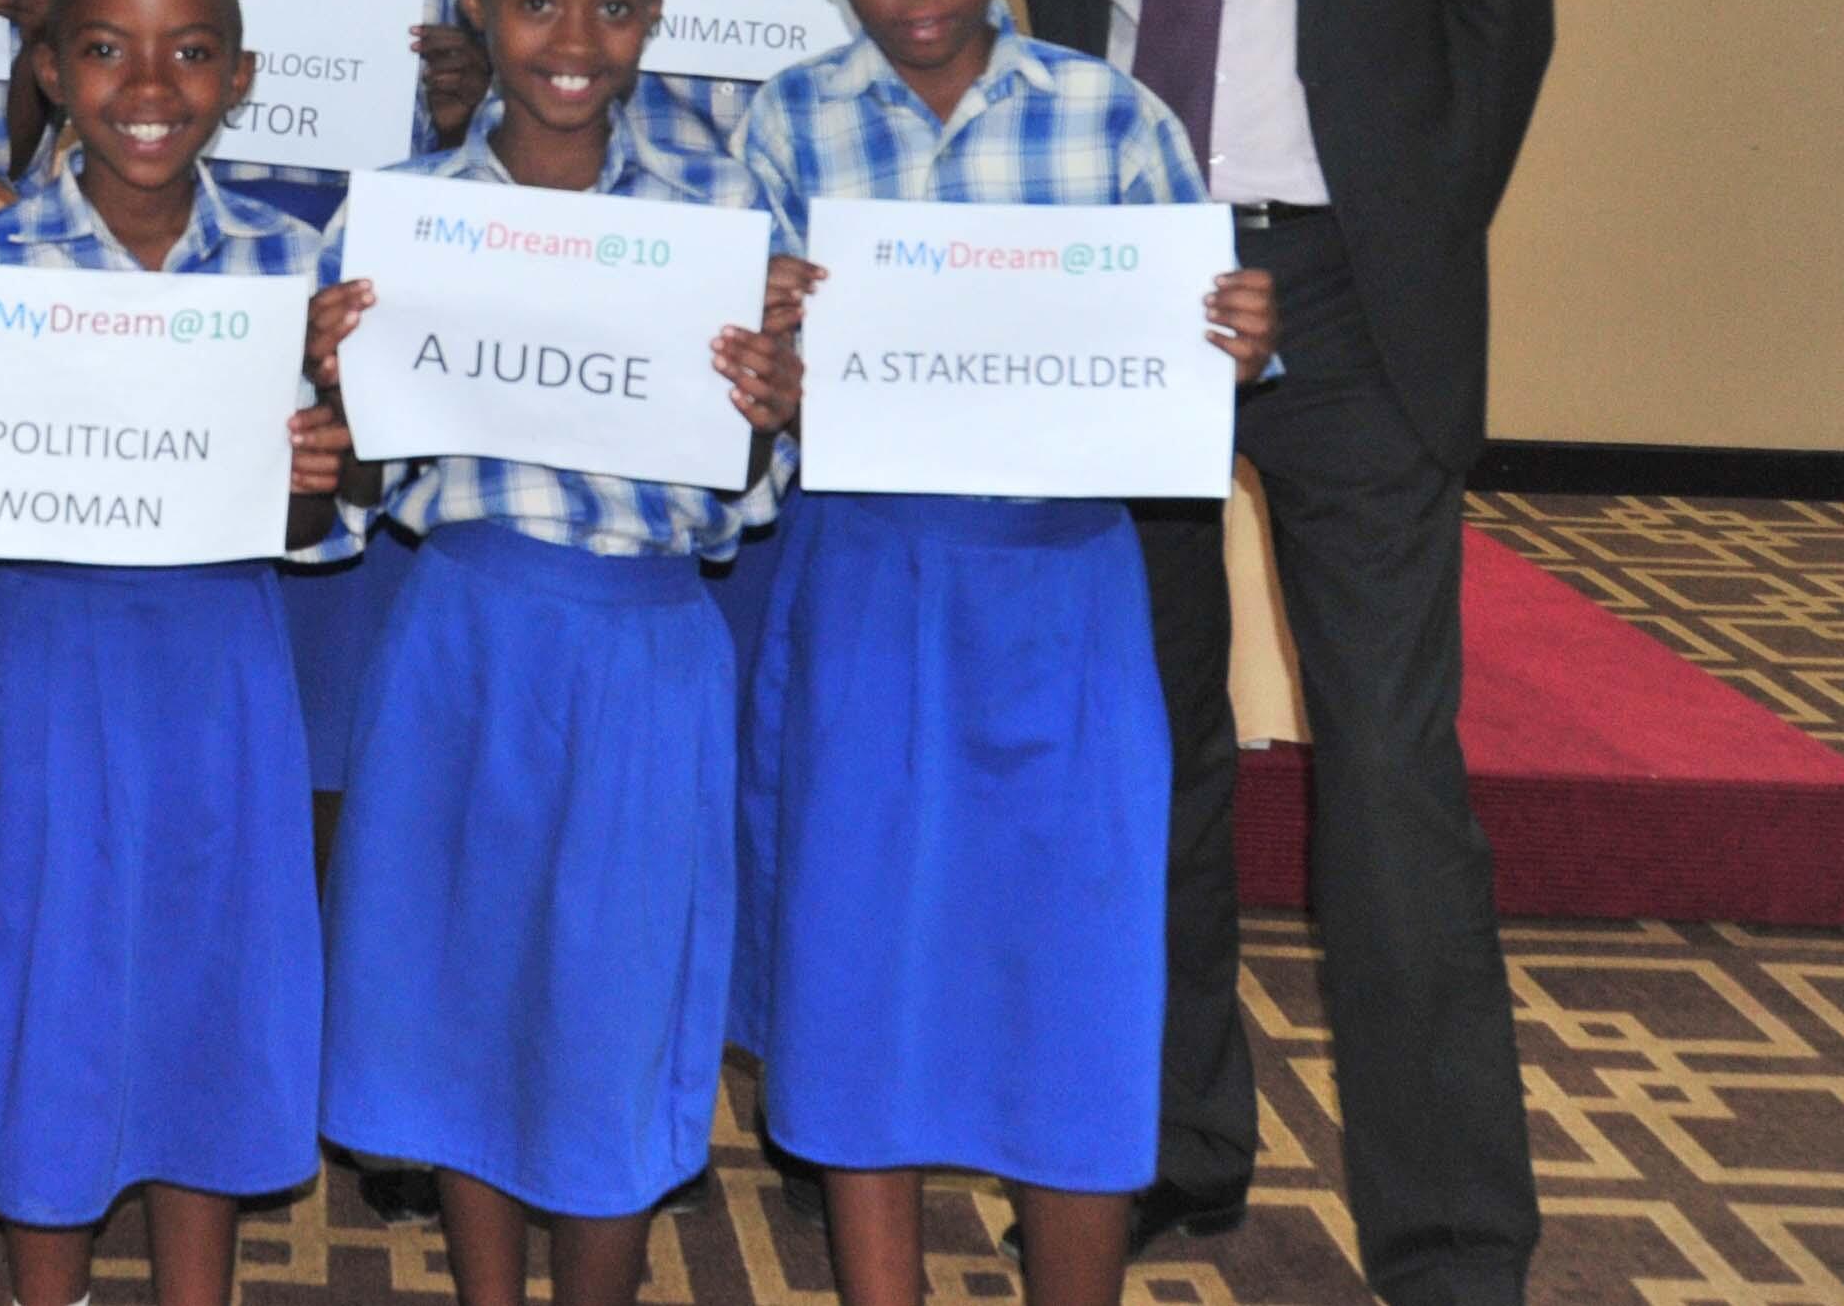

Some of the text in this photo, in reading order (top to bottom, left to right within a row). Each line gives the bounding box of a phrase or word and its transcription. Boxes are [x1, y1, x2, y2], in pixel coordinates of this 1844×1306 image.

[222, 103, 319, 138] CTOR
[415, 216, 671, 267] #MyDream@10
[875, 240, 1138, 275] #MyDream@10
[413, 334, 649, 399] A JUDGE
[842, 352, 1164, 388] A STAKEHOLDER
